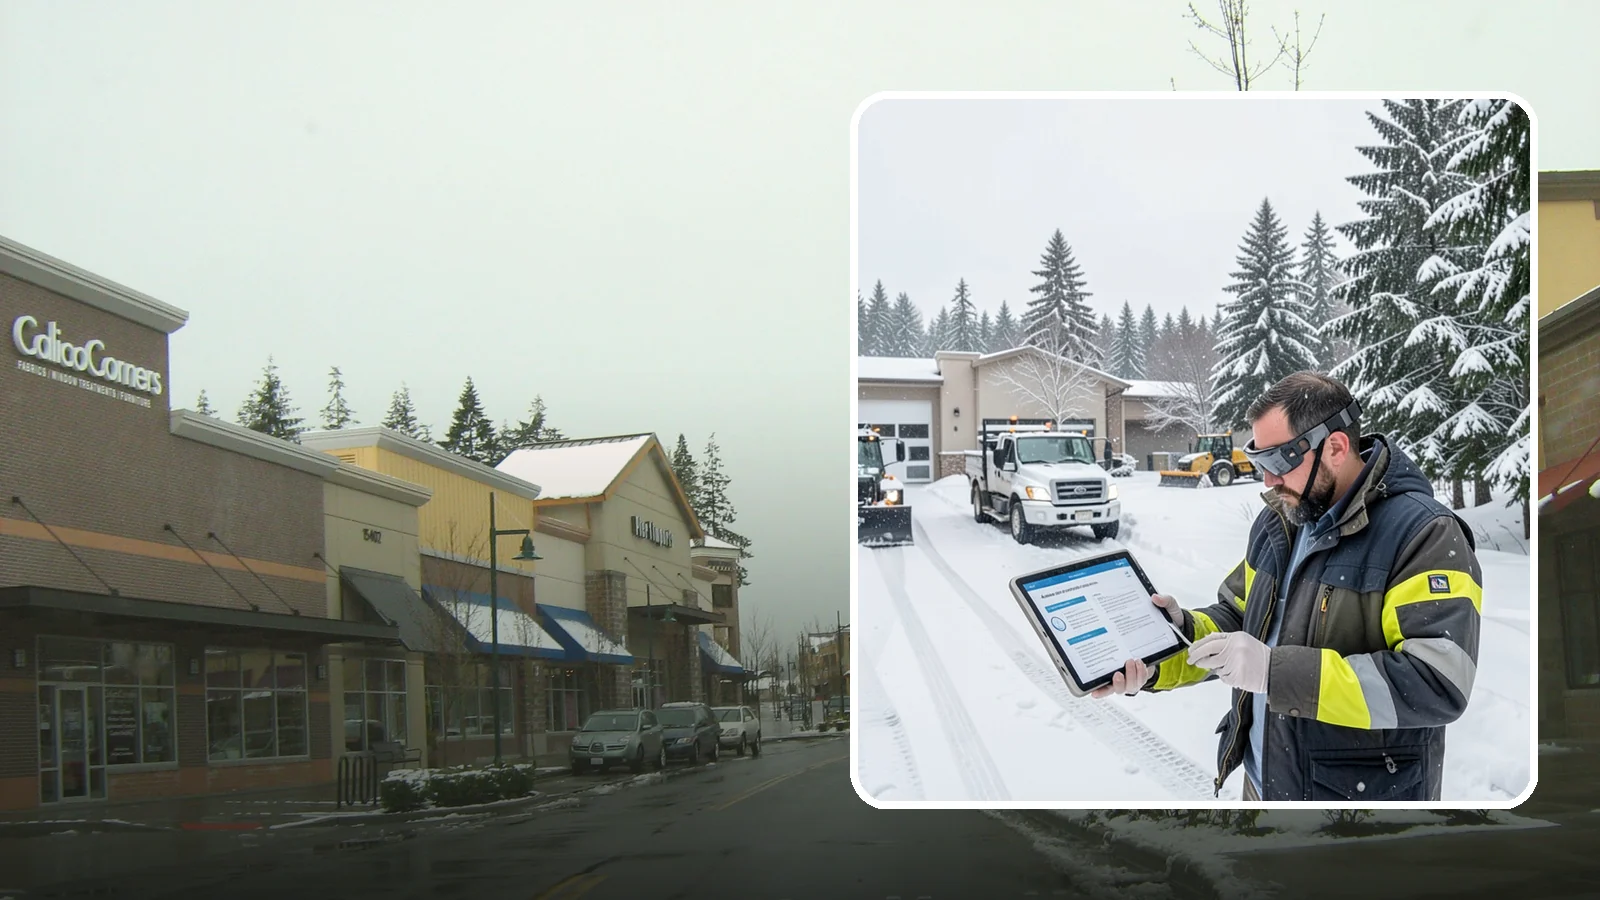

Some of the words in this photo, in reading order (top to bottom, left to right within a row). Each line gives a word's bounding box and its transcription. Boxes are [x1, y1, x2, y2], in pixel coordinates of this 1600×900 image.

[17, 359, 47, 378] FABRICS
[51, 370, 78, 387] WINDOW
[79, 378, 116, 398] TREATMENTS
[120, 391, 151, 409] FURNITURE
